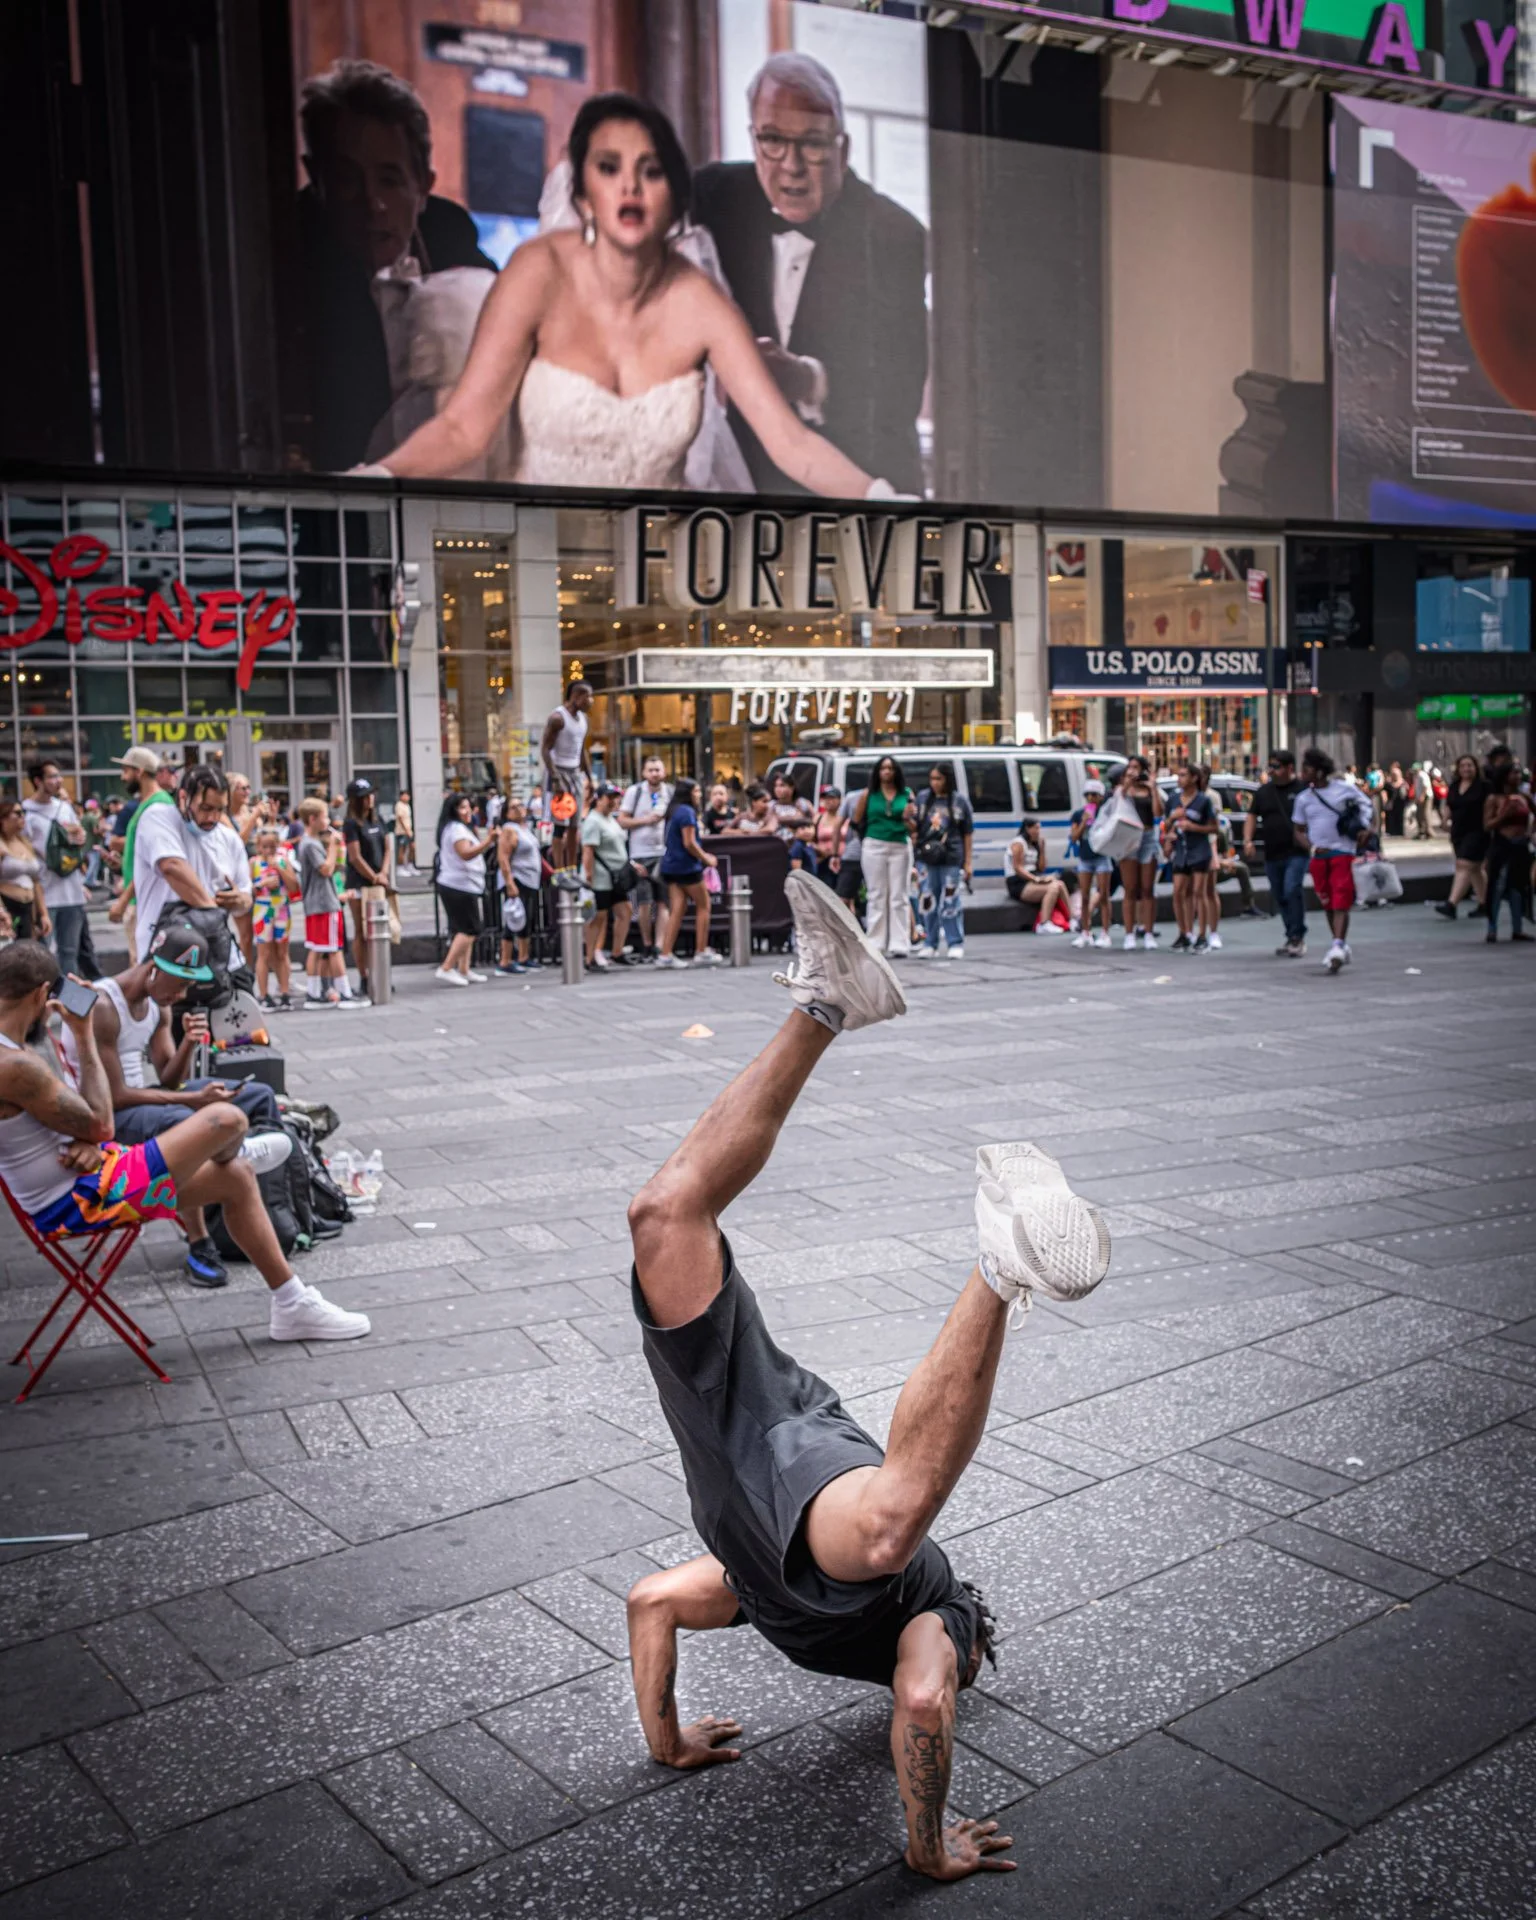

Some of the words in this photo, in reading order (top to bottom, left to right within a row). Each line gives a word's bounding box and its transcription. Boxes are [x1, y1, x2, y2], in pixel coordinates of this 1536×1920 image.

[624, 505, 993, 617] FOREVER
[1086, 651, 1128, 674] U.S.
[1131, 651, 1195, 675] POLO
[1197, 651, 1263, 675] ASSN.
[1147, 676, 1177, 687] SINCE
[729, 687, 872, 726] FOREVER
[885, 687, 915, 724] 21
